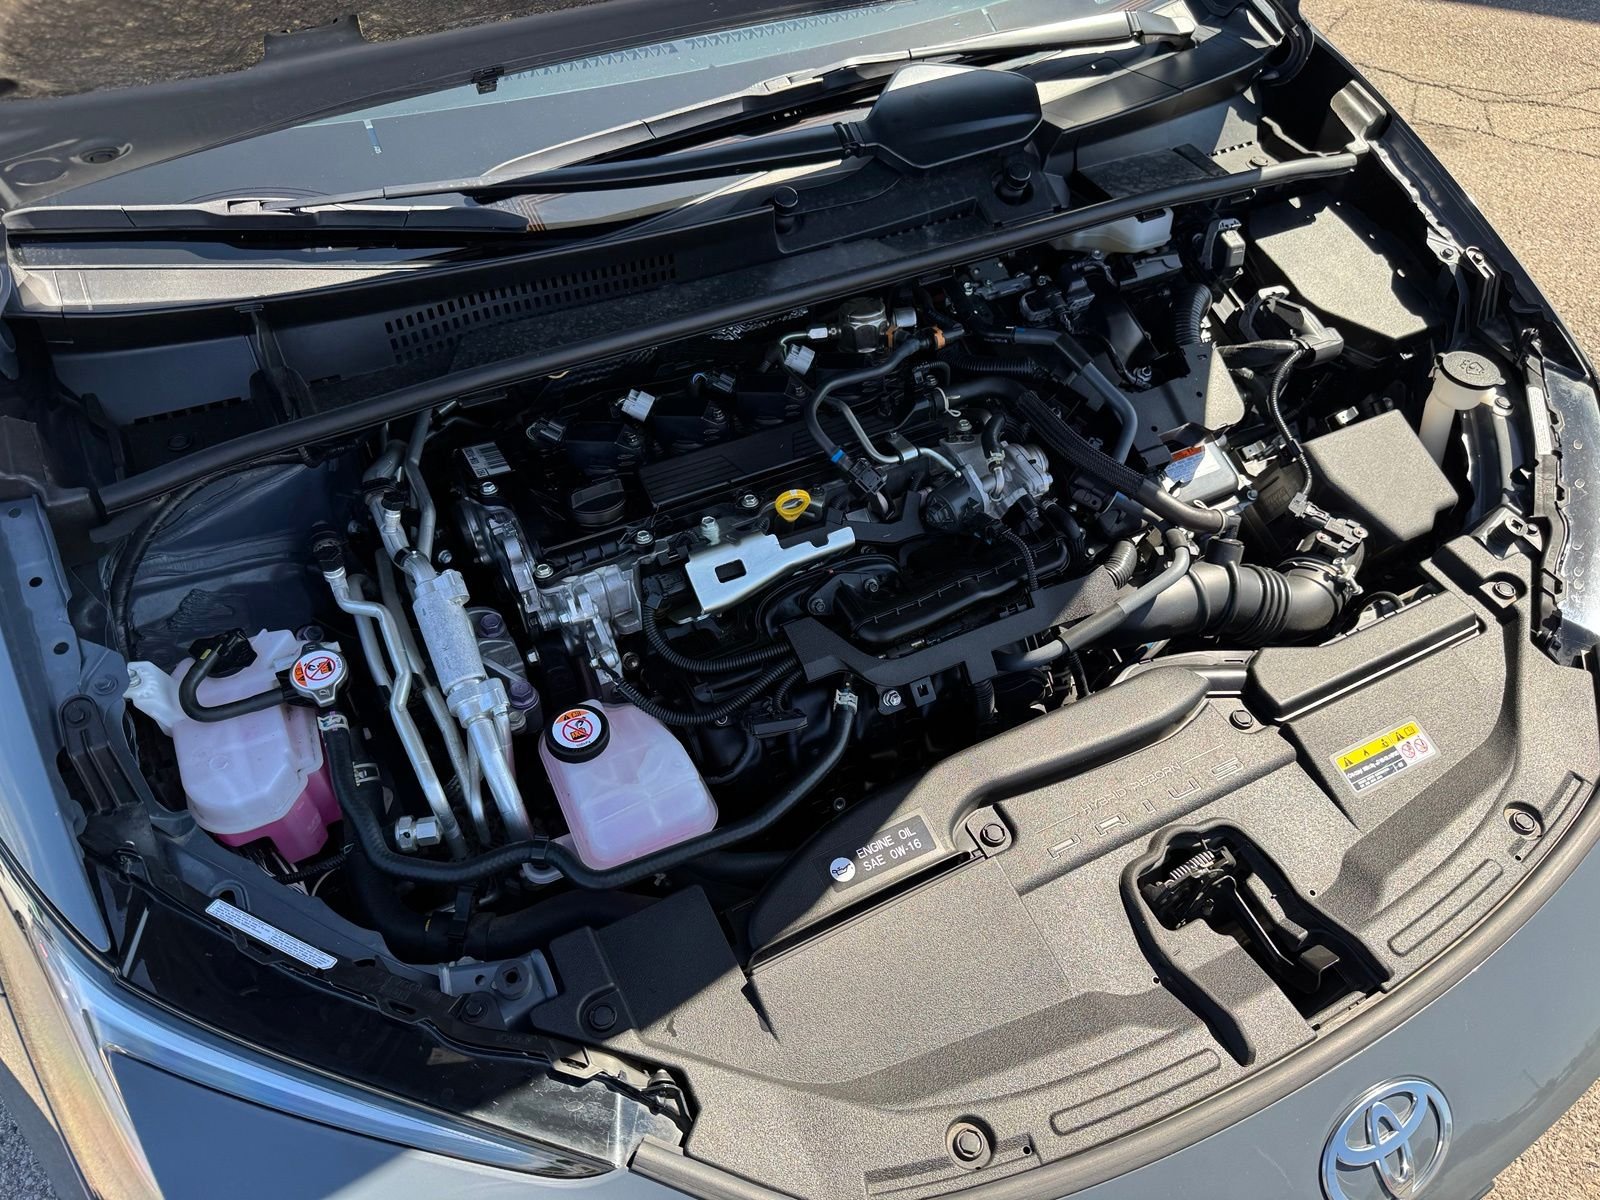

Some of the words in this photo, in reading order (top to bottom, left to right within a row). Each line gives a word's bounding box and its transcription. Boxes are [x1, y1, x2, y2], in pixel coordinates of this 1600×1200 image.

[1047, 757, 1244, 860] PRIUS
[856, 835, 895, 859] ENGINE
[898, 826, 917, 840] OIL
[863, 854, 886, 871] SAE
[889, 838, 922, 860] 0W-16
